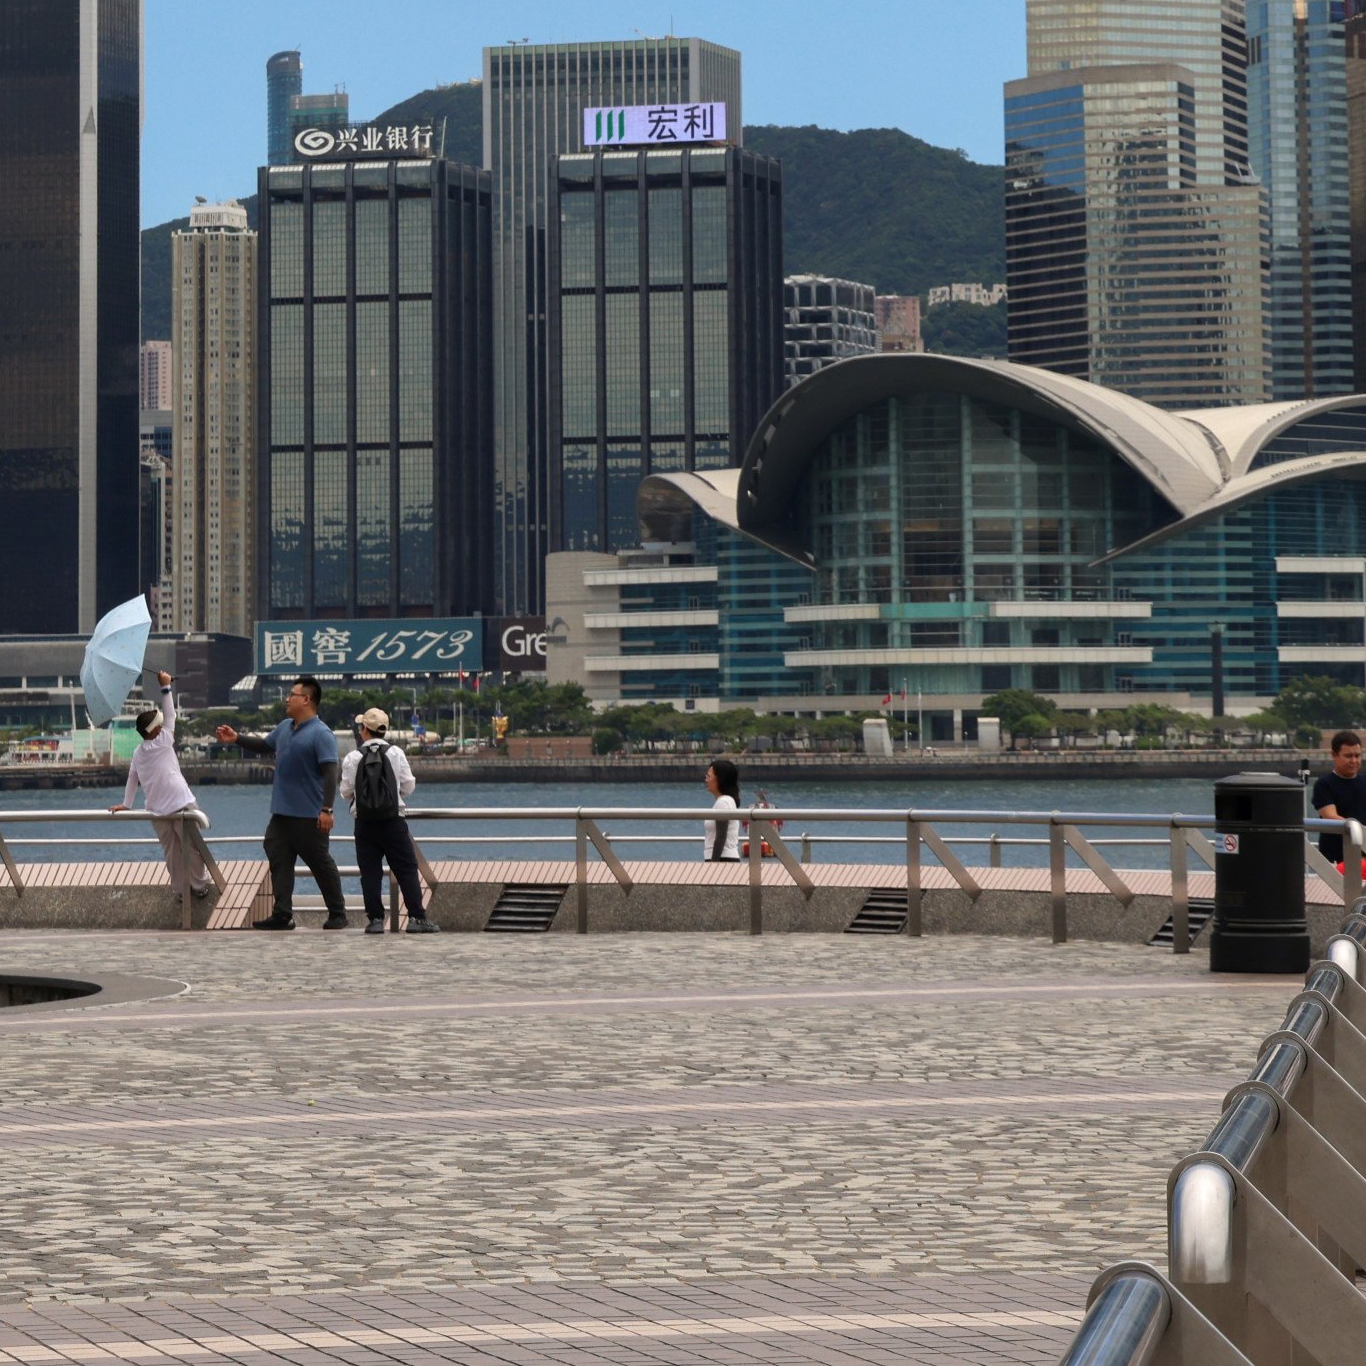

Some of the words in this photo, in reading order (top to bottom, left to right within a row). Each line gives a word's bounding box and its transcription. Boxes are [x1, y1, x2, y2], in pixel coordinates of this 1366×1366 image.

[336, 125, 433, 152] 兴业银行
[648, 104, 714, 140] 宏利
[355, 629, 474, 662] 1573
